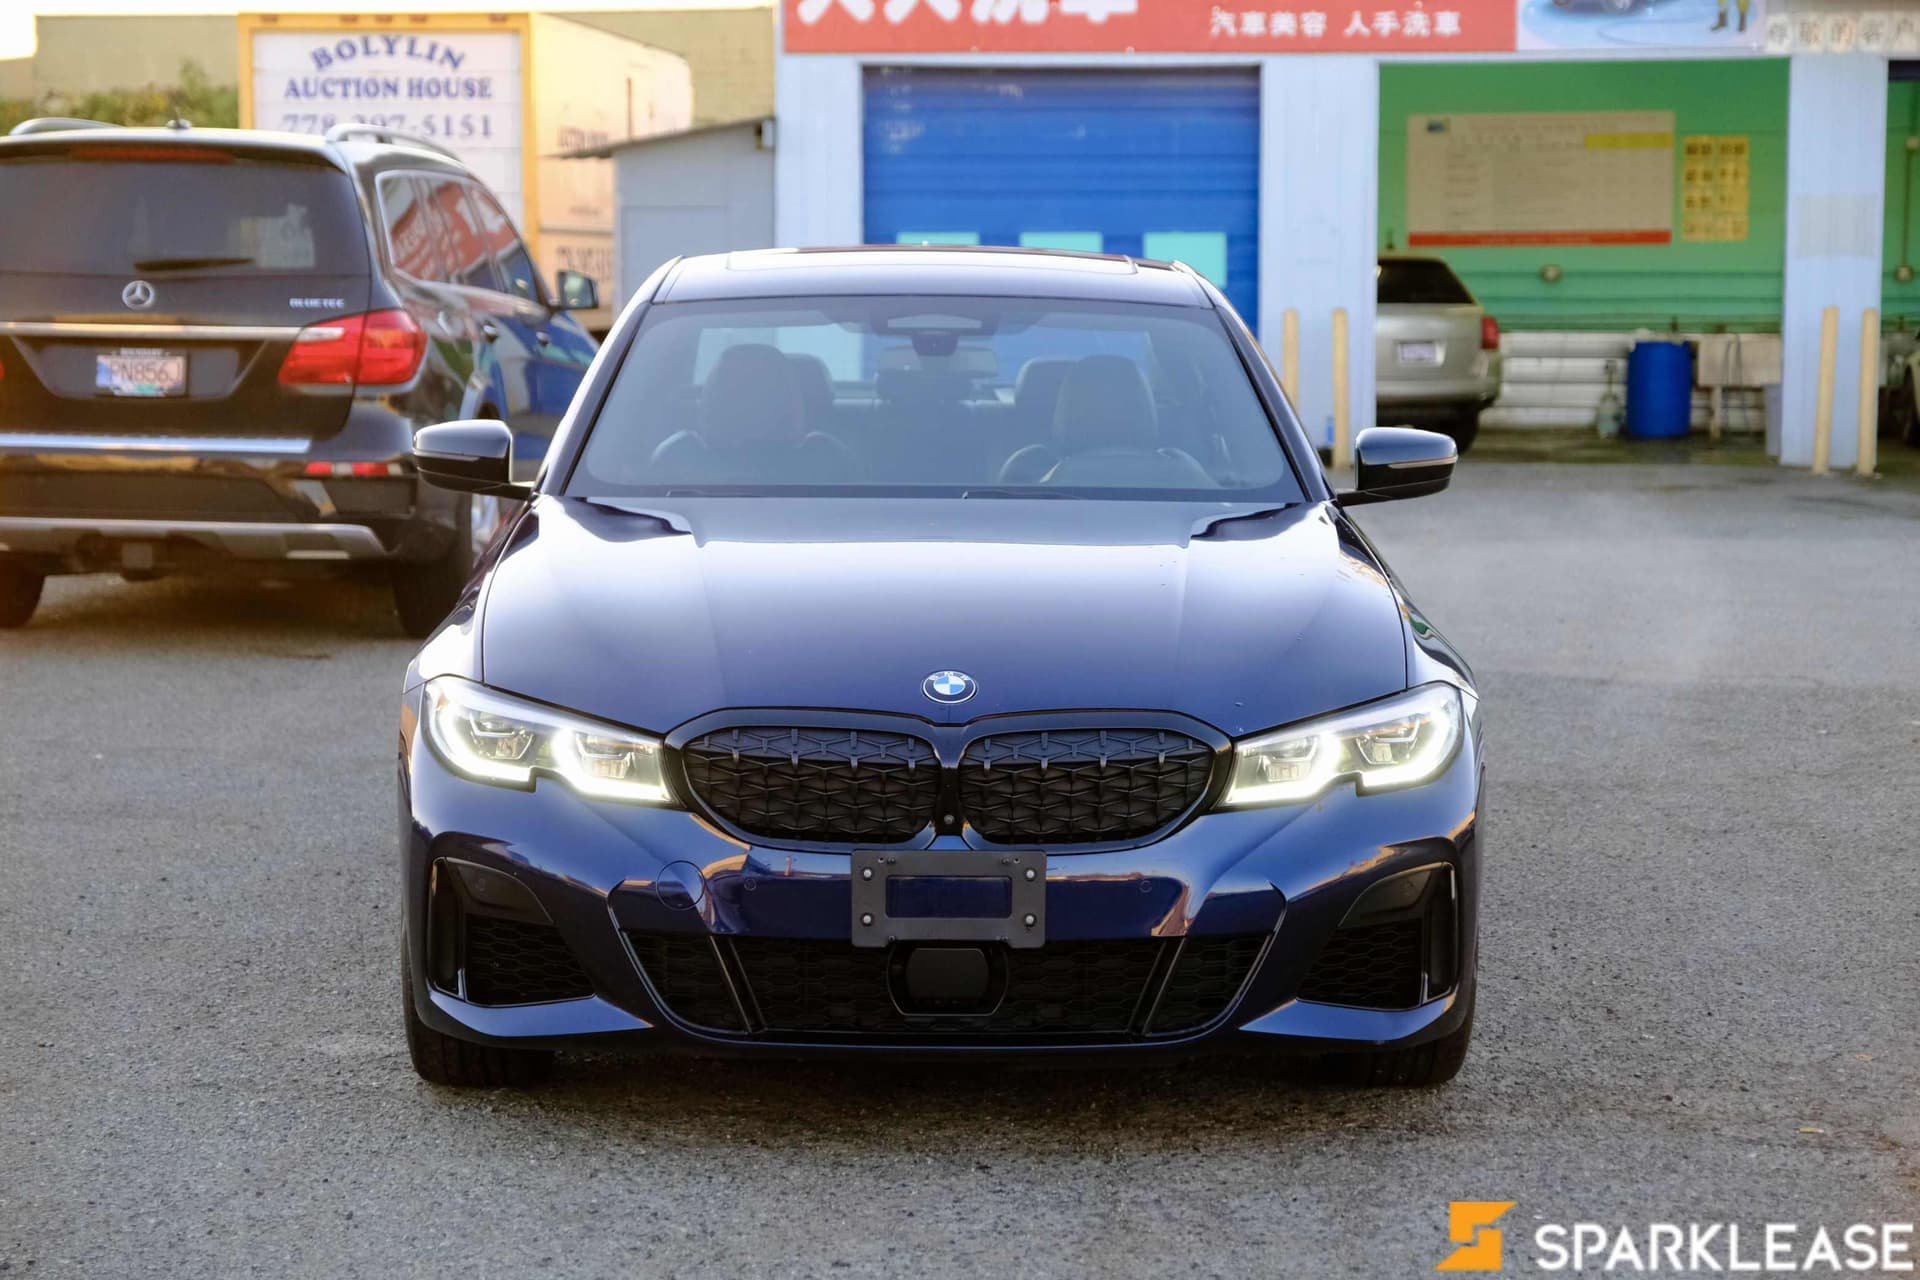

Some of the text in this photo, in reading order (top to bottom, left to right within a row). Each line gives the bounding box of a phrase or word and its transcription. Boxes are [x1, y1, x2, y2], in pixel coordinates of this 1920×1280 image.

[1210, 8, 1462, 37] 汽車美容 人手洗車
[310, 35, 466, 70] BOLYLIN
[284, 77, 492, 98] AUCTION HOUSE
